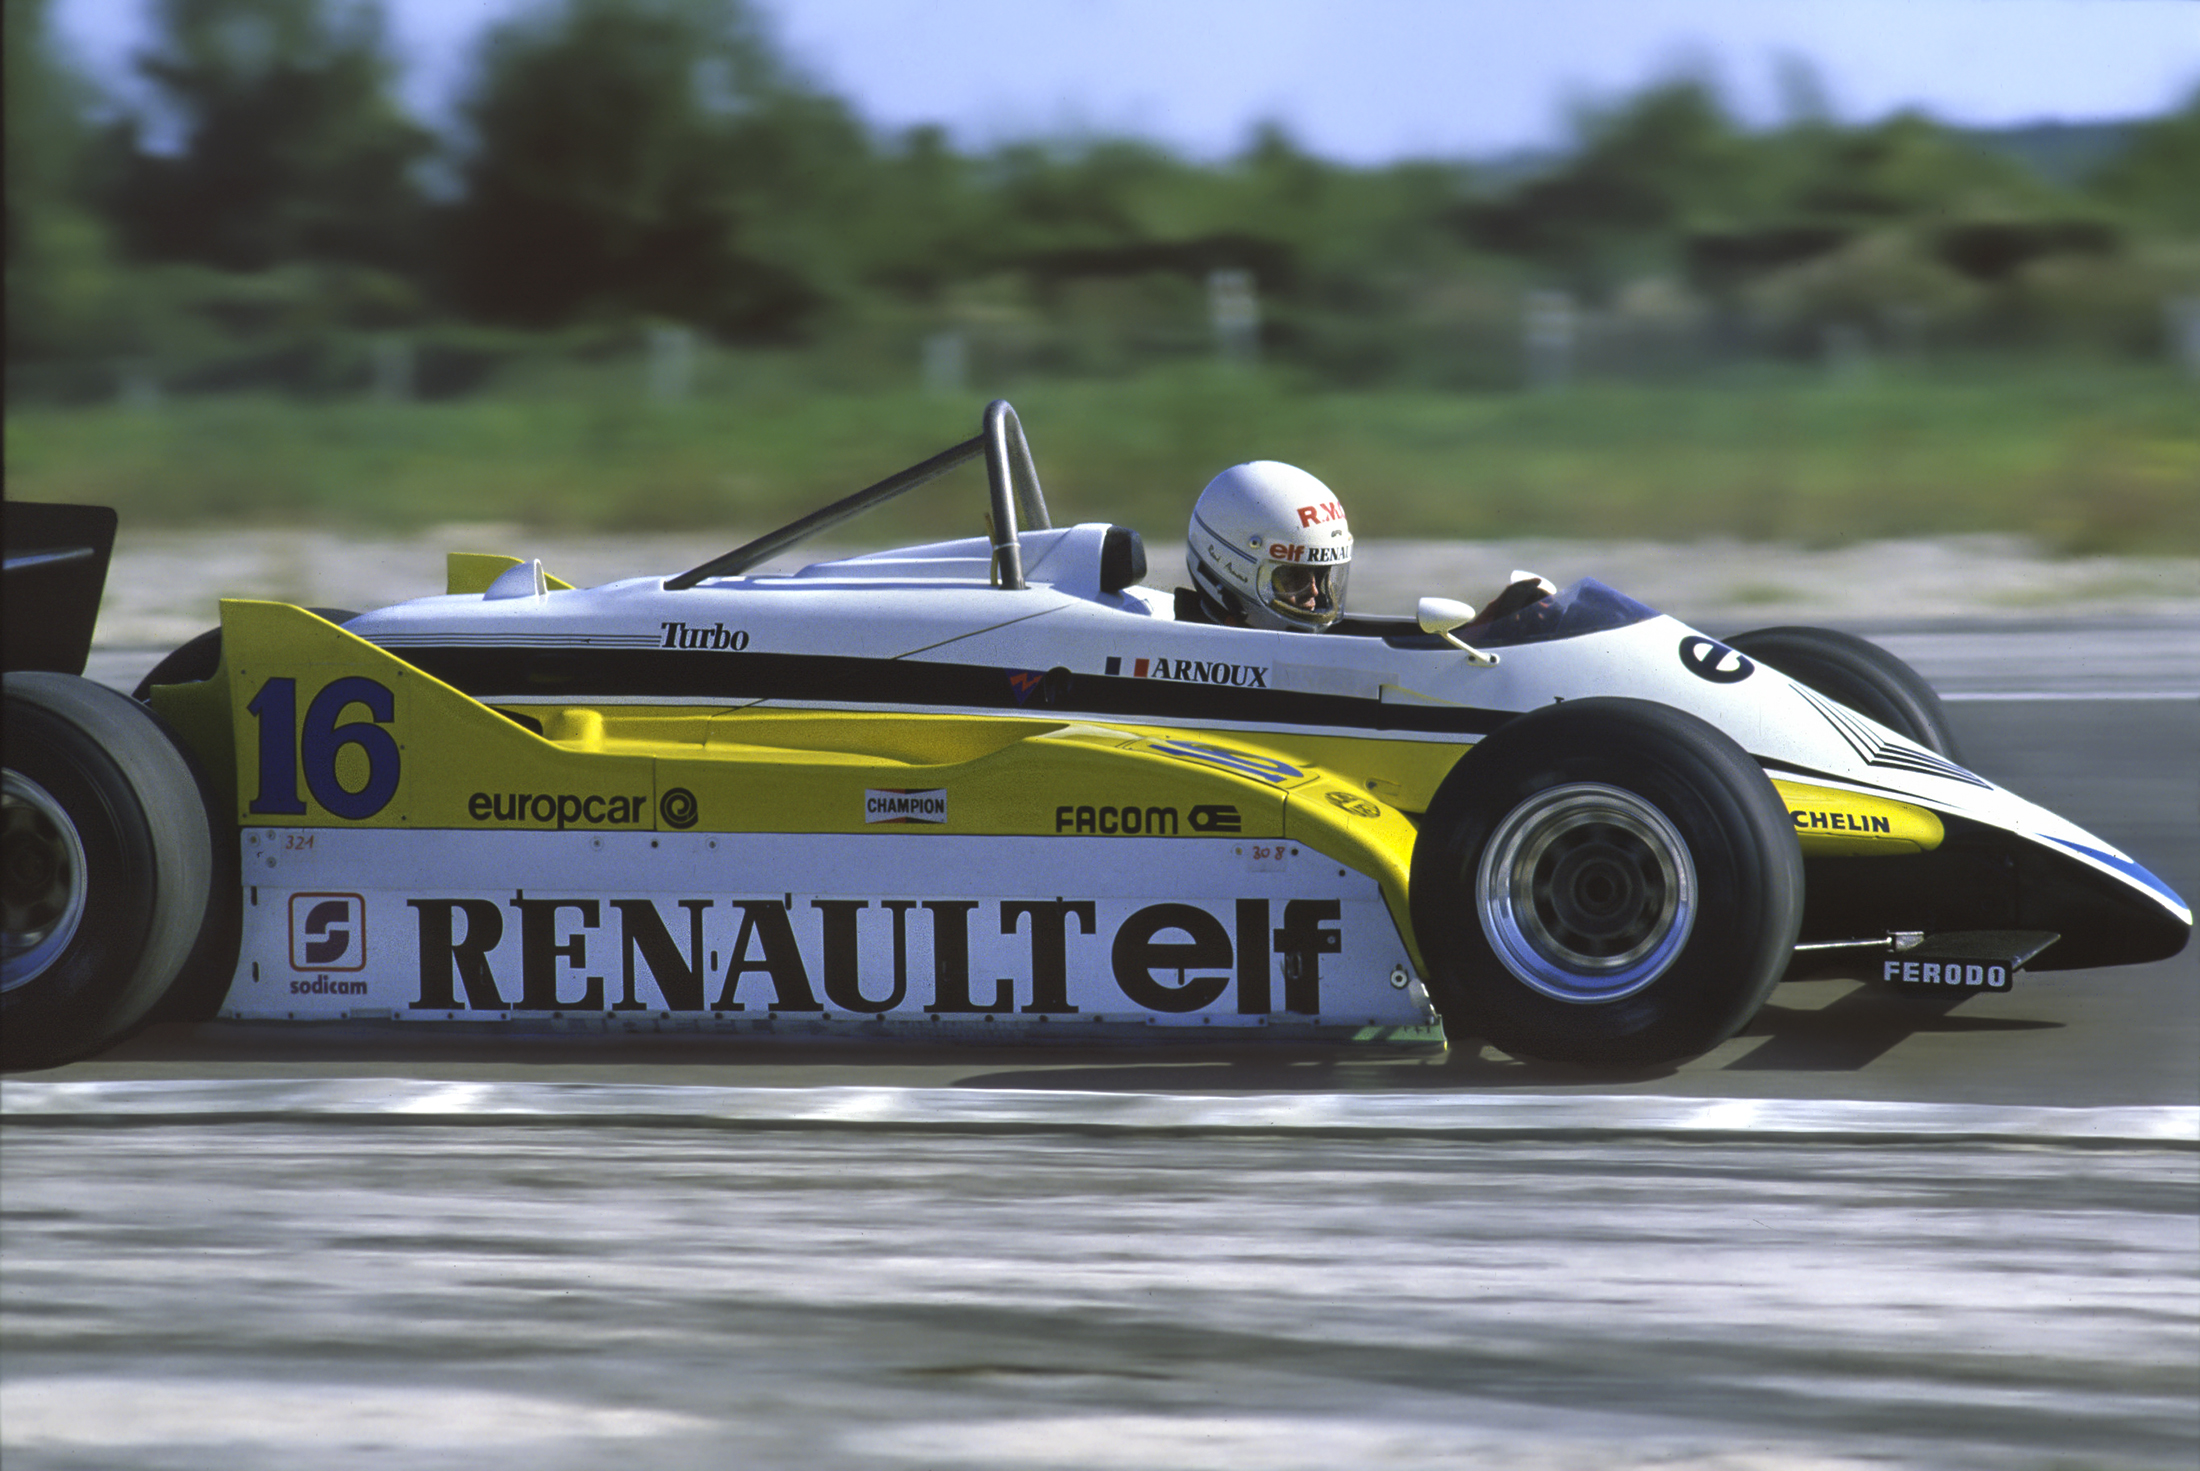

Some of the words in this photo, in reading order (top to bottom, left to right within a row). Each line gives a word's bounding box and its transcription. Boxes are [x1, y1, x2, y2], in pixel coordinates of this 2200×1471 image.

[1269, 543, 1305, 562] elf
[661, 622, 750, 651] Turbo
[1151, 657, 1269, 688] ARNOUX
[246, 676, 400, 819] 16
[468, 792, 647, 830] europcar
[867, 798, 944, 813] CHAMPION
[1056, 806, 1178, 835] FACOM
[286, 835, 314, 850] 321
[407, 898, 1096, 1014] RENAULT
[1111, 898, 1341, 1014] elf
[290, 974, 368, 995] sodicam
[1884, 961, 2006, 987] FERODO
